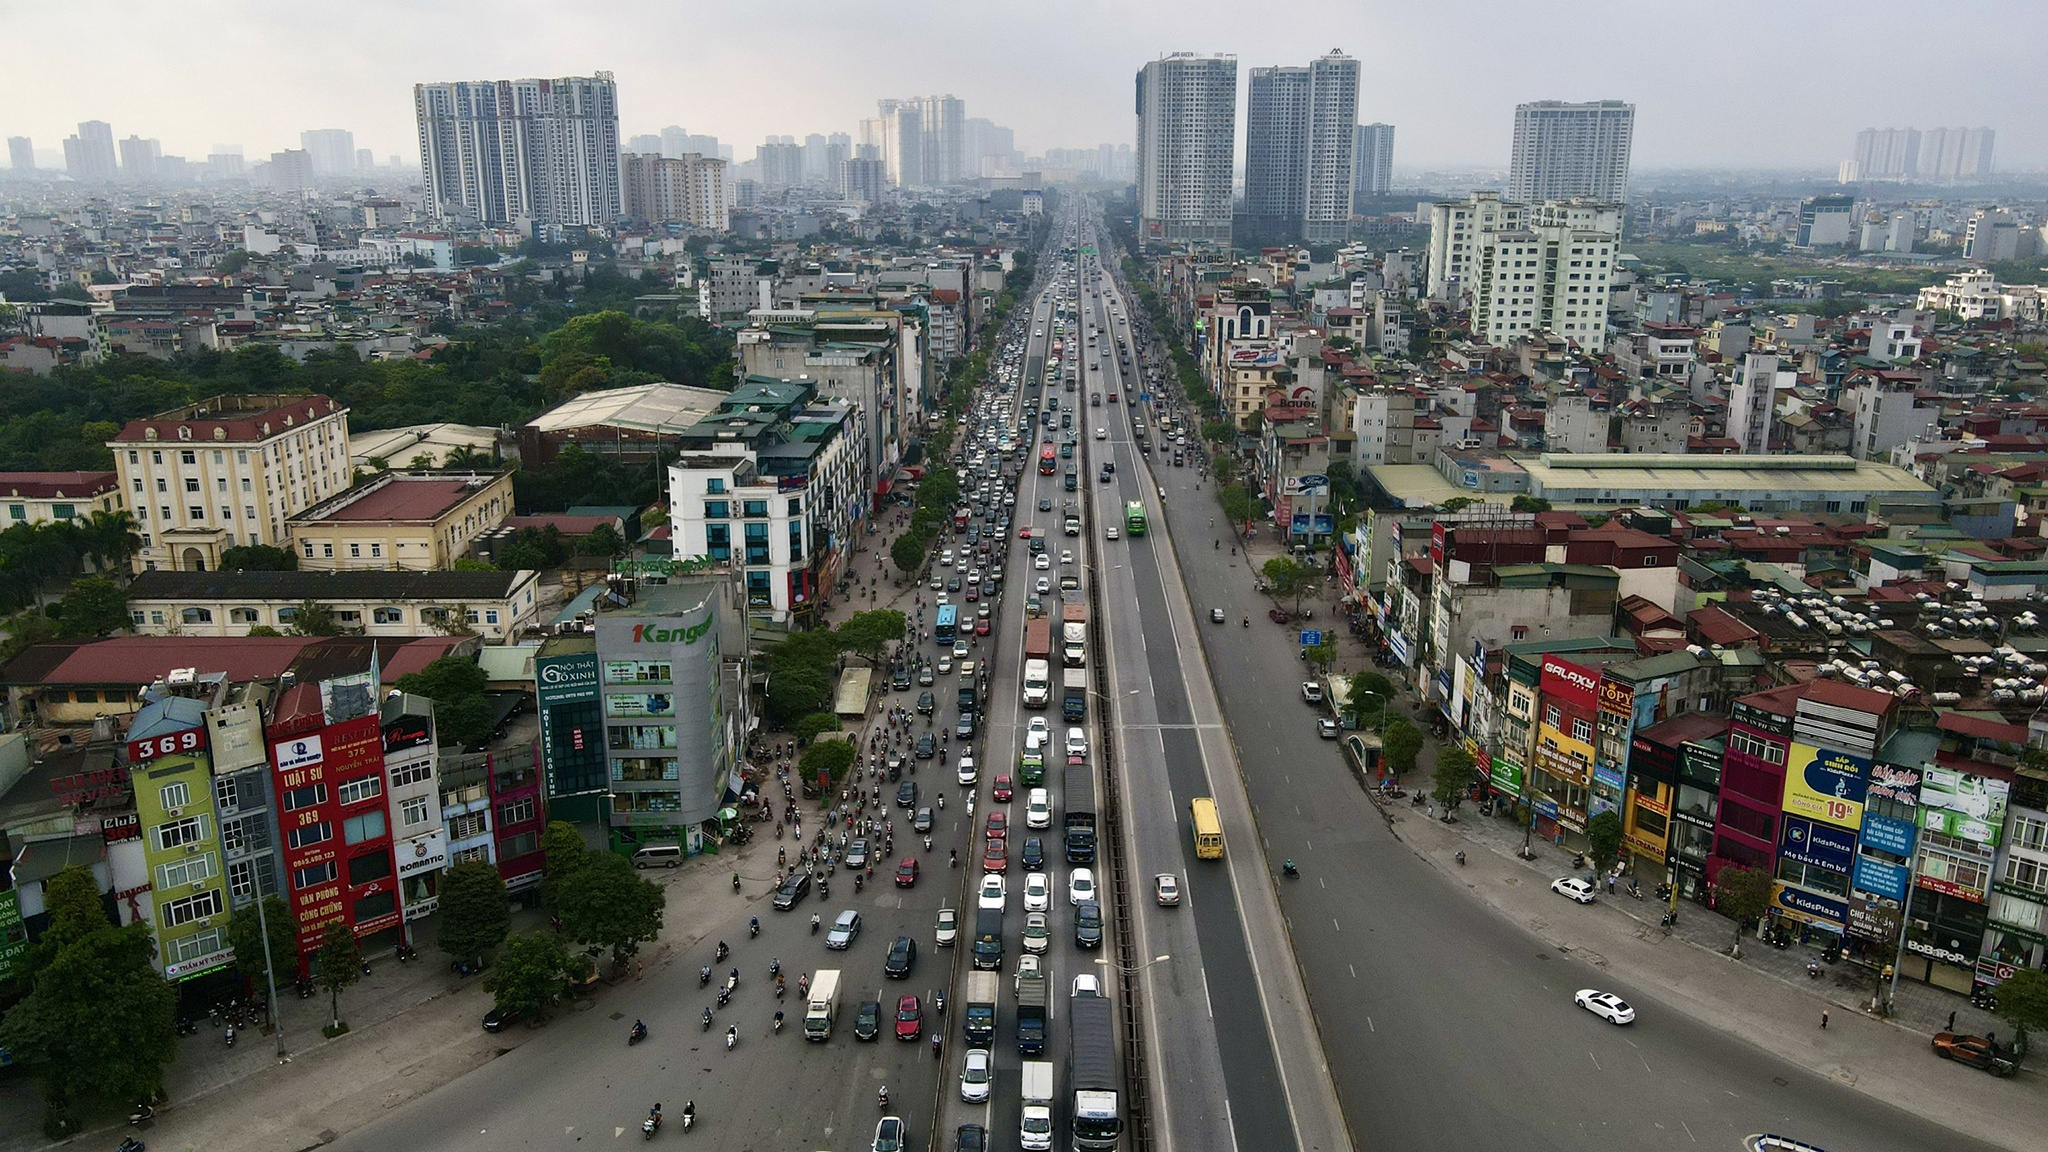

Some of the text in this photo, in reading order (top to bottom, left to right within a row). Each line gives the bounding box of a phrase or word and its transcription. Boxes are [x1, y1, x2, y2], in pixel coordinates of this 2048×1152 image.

[1280, 399, 1316, 409] Bauer
[1305, 476, 1325, 485] Ford
[560, 661, 594, 671] NỘI THẤT
[569, 671, 595, 681] XINH
[1544, 662, 1596, 690] GALAXY
[1600, 685, 1633, 705] TOPY
[139, 732, 197, 758] 369
[348, 747, 366, 758] 375
[335, 760, 363, 773] NGUYỄN
[1824, 759, 1843, 770] SINH
[1835, 755, 1850, 764] SẮP
[284, 765, 323, 787] LUẬT SƯ
[1827, 766, 1853, 778] KidsPlaza
[104, 814, 137, 829] Club
[299, 810, 319, 826] 369
[105, 825, 140, 841] 367
[1812, 836, 1851, 852] KidsPlaza
[400, 854, 444, 873] ROMANTIO
[1784, 850, 1797, 859] Mẹ
[1821, 860, 1835, 870] Em
[316, 886, 339, 901] PHÒNG
[300, 901, 343, 922] CÔNG CHỨNG
[1796, 898, 1840, 917] KidsPlaza
[1850, 908, 1864, 920] CHỢ
